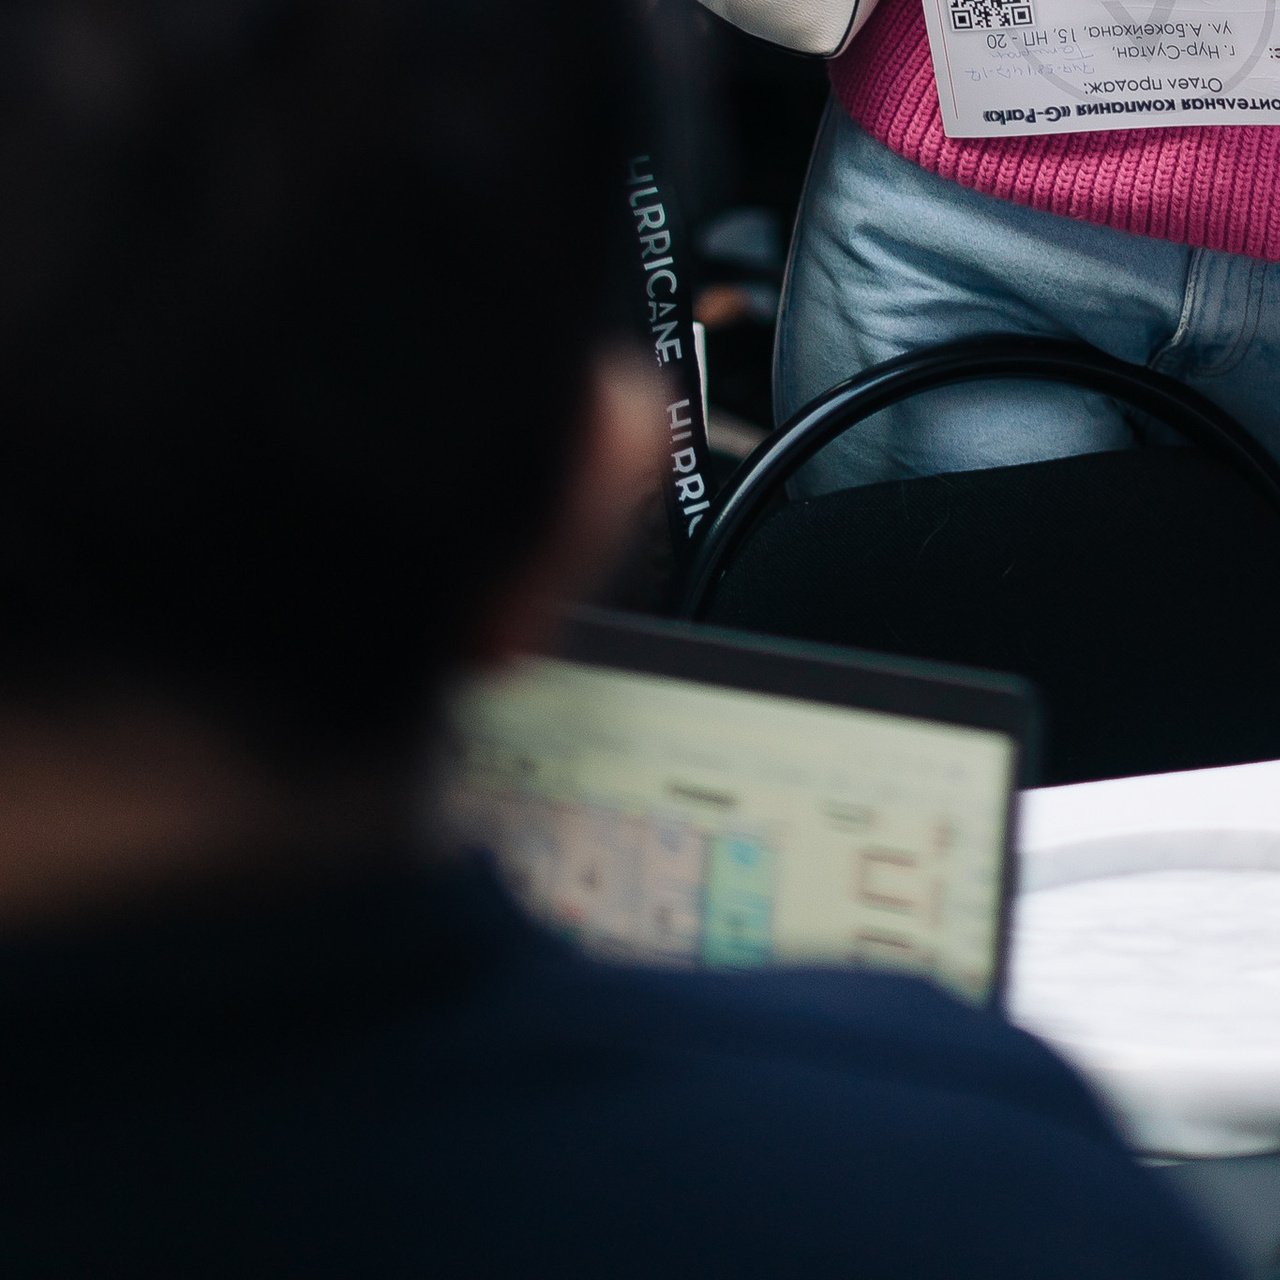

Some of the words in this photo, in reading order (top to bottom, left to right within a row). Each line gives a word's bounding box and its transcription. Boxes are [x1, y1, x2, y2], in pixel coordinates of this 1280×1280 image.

[1053, 27, 1077, 43] 15,
[1083, 23, 1202, 39] А.Бокейхана,
[1207, 20, 1232, 35] ул.
[986, 33, 1007, 49] 20
[1023, 32, 1048, 46] НП
[1111, 41, 1219, 59] Нур-Султан,
[1224, 44, 1236, 55] г.
[1083, 76, 1163, 95] продаж:
[1166, 77, 1223, 93] Отдел
[983, 106, 1071, 125] «G-Park»
[1076, 98, 1176, 117] компания
[626, 155, 683, 363] HURRICANE
